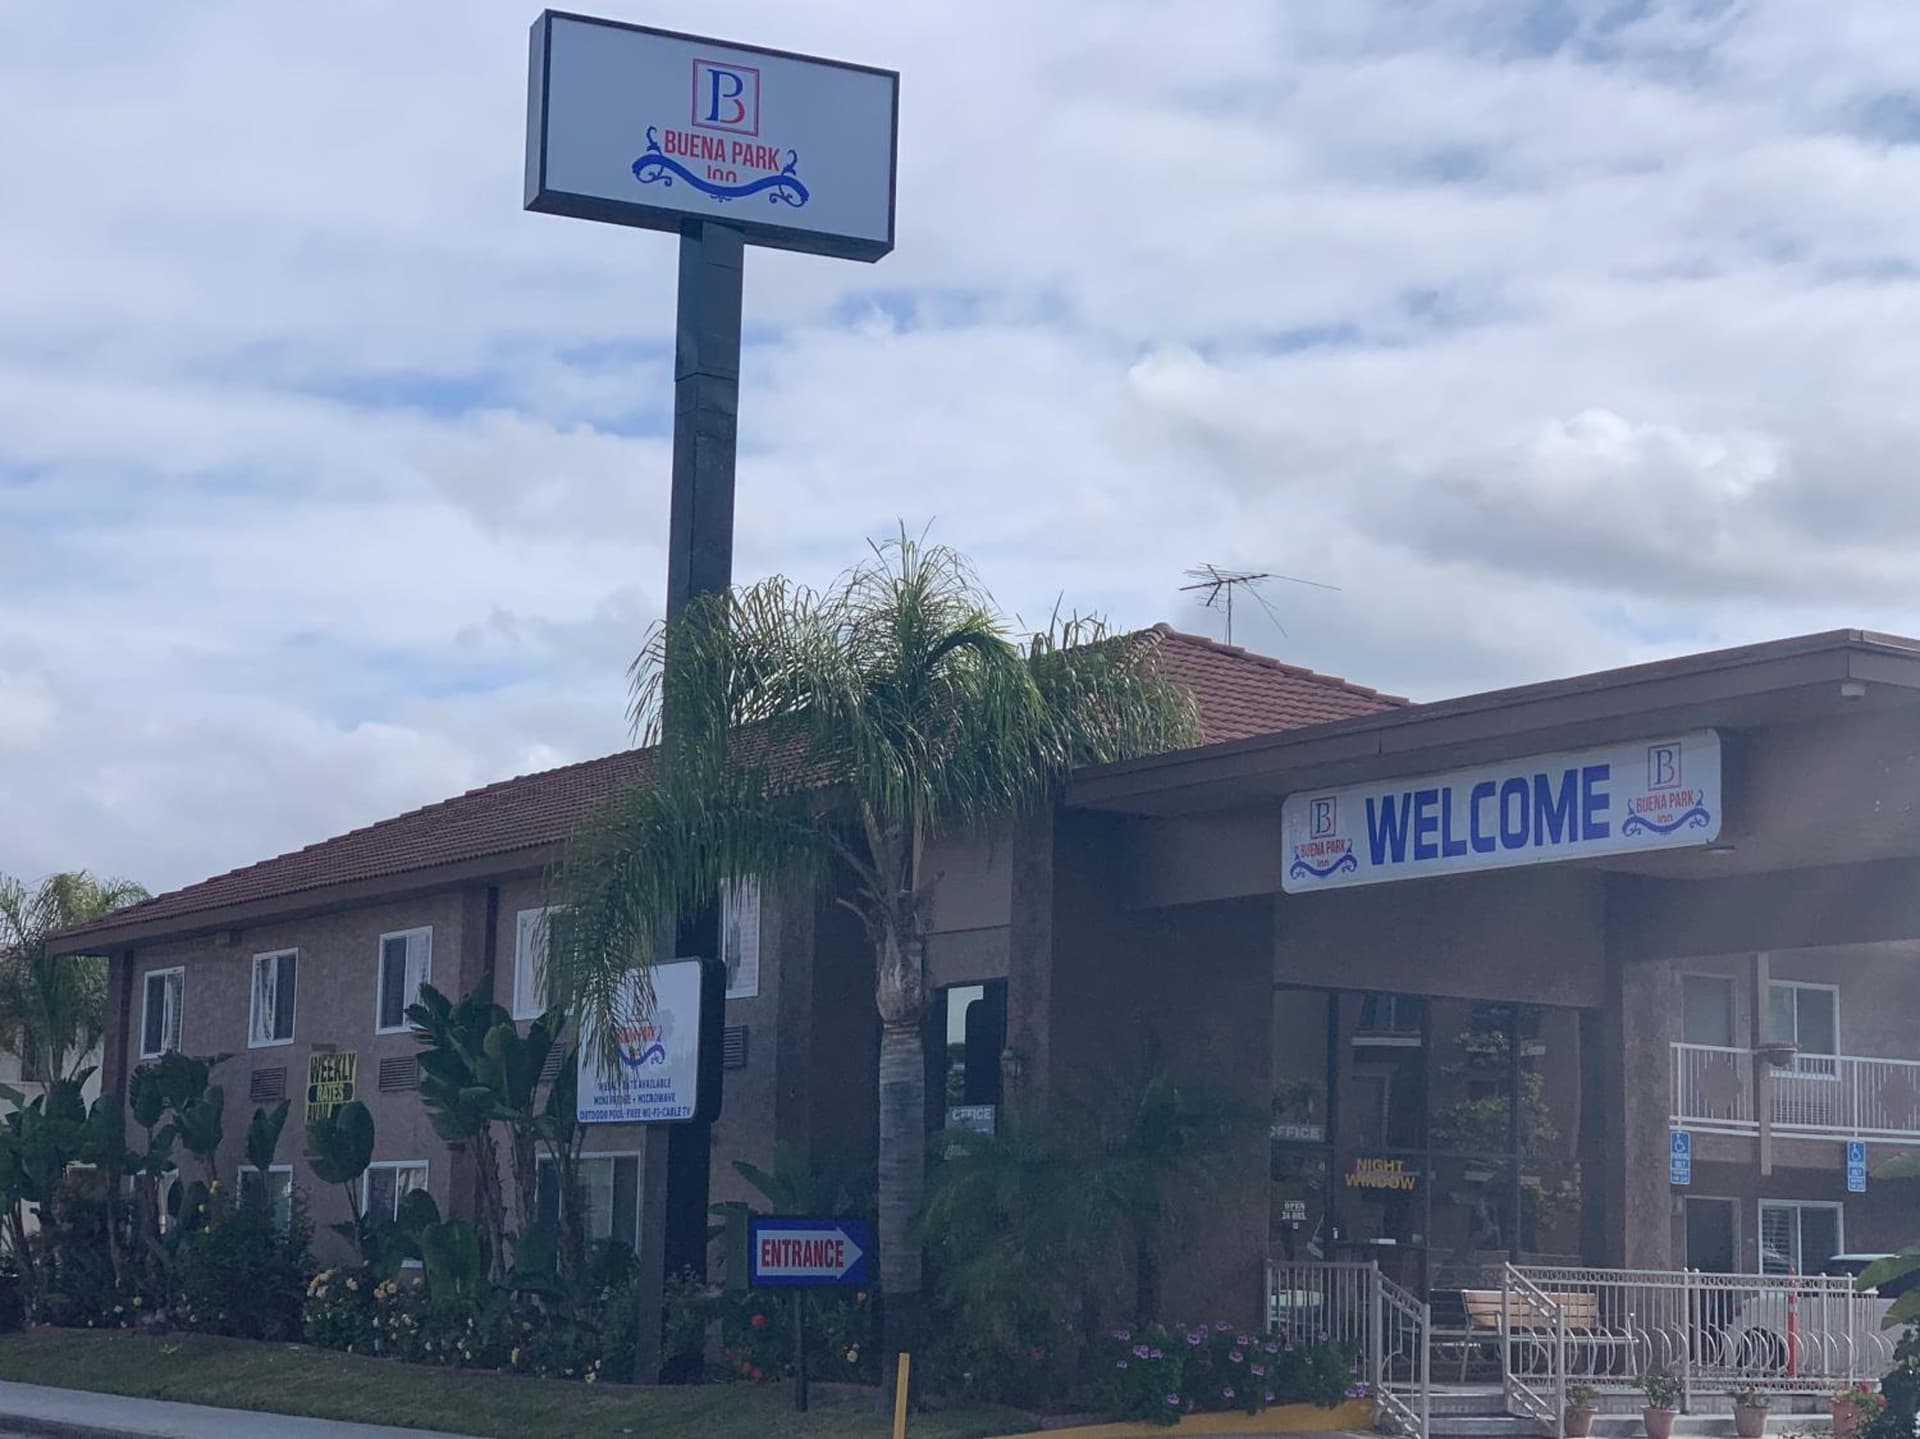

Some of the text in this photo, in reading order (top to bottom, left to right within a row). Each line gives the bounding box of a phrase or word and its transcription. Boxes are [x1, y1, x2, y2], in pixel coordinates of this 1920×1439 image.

[705, 68, 745, 124] B
[664, 130, 780, 171] BUENA PARK
[706, 165, 737, 183] Inn
[1655, 749, 1674, 785] B
[1636, 790, 1694, 814] BUENA PARK
[1315, 802, 1331, 834] B
[1365, 764, 1611, 866] WELCOME
[1301, 840, 1345, 858] BUENA PARK
[310, 1052, 356, 1084] WEEKLY
[316, 1083, 344, 1102] RATES
[638, 1077, 672, 1090] AVAILABLE
[638, 1093, 676, 1104] MICROWAVE
[580, 1110, 608, 1120] OUTDOOR
[1356, 1158, 1405, 1172] NIGHT
[1345, 1173, 1416, 1190] WINDOW
[1284, 1202, 1305, 1211] OPEN
[761, 1239, 844, 1268] ENTRANCE
